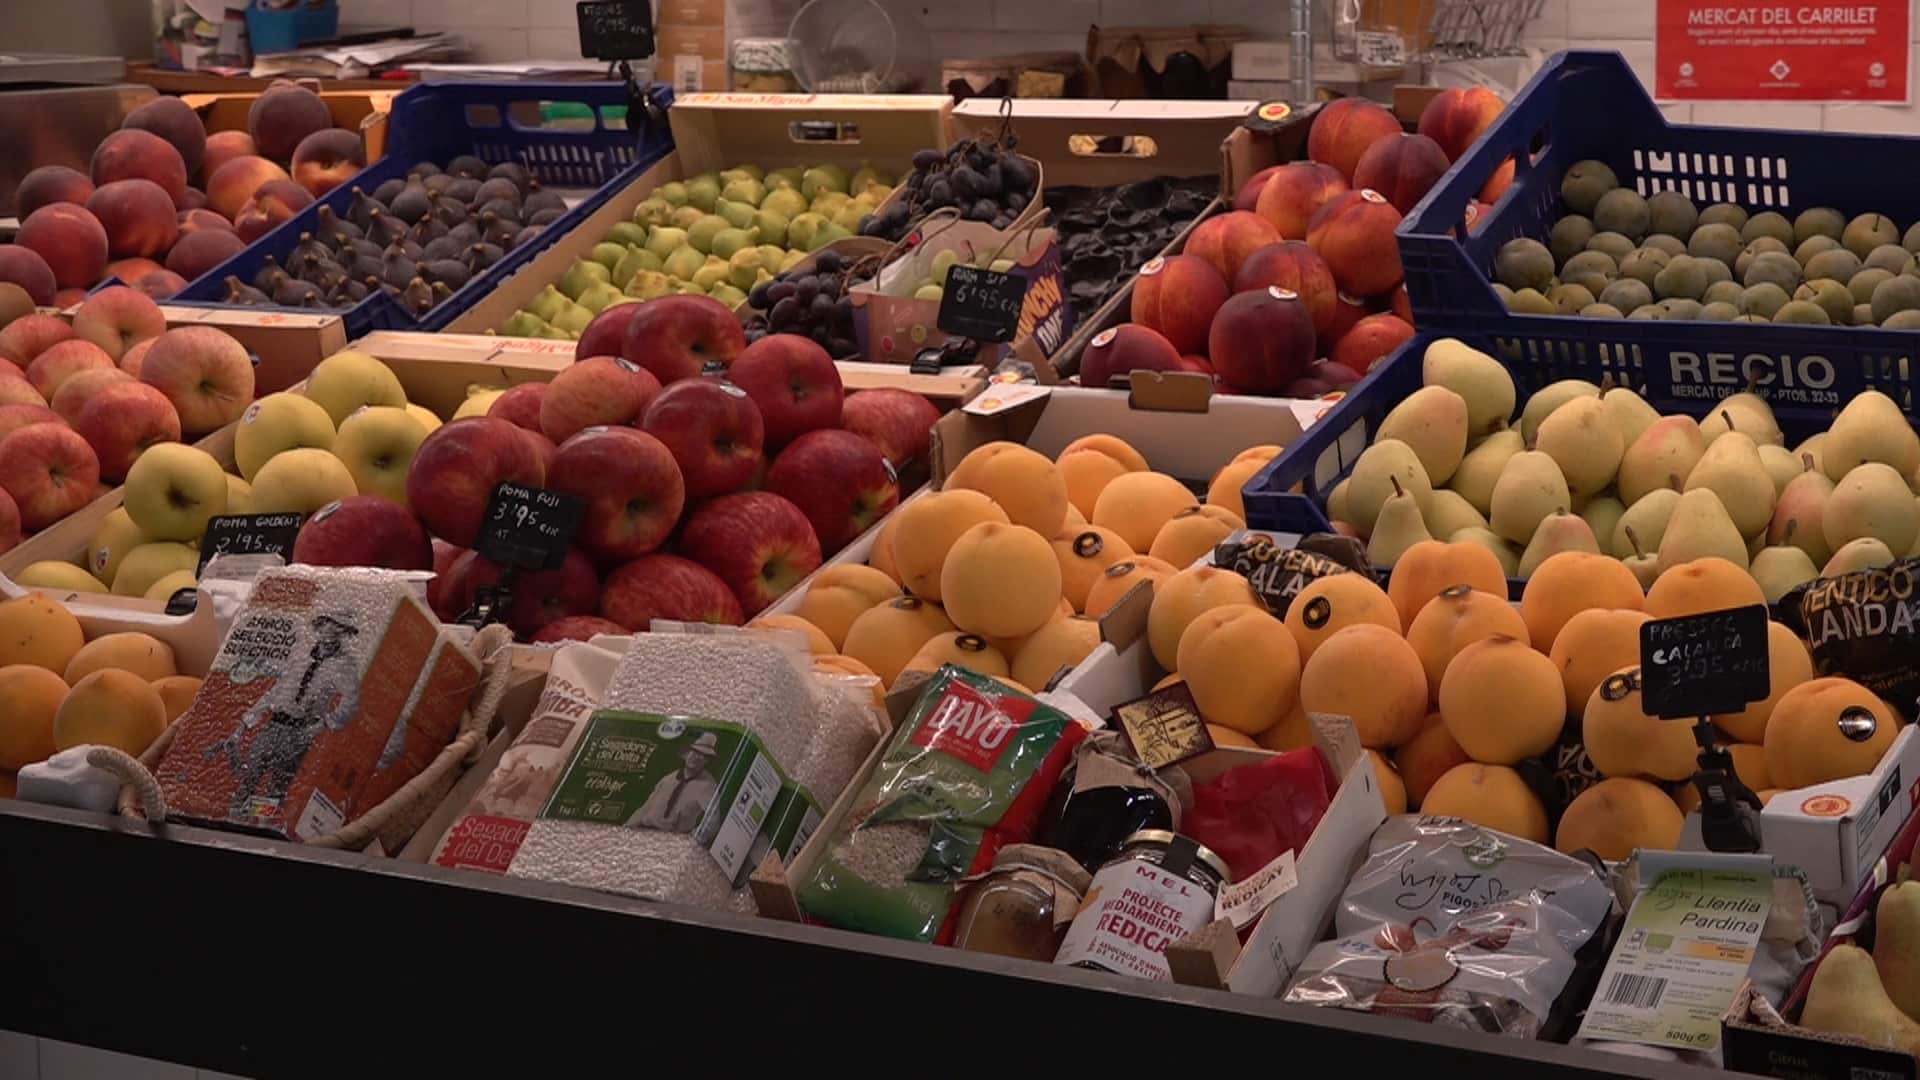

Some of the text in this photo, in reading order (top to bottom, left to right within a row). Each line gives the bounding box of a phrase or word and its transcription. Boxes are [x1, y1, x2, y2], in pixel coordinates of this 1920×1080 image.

[1688, 7, 1877, 24] MERCAT DEL CARRILET
[1669, 351, 1835, 389] RECIO
[1671, 384, 1715, 398] MERCAT
[498, 483, 560, 507] POMA FUJI
[214, 517, 247, 530] POMA
[493, 501, 540, 528] 3'95
[928, 695, 1013, 750] BAYO
[1136, 865, 1192, 898] MEL
[1122, 887, 1184, 922] PROJECTE
[1679, 911, 1760, 935] Pardina
[1665, 1030, 1695, 1043] 500g
